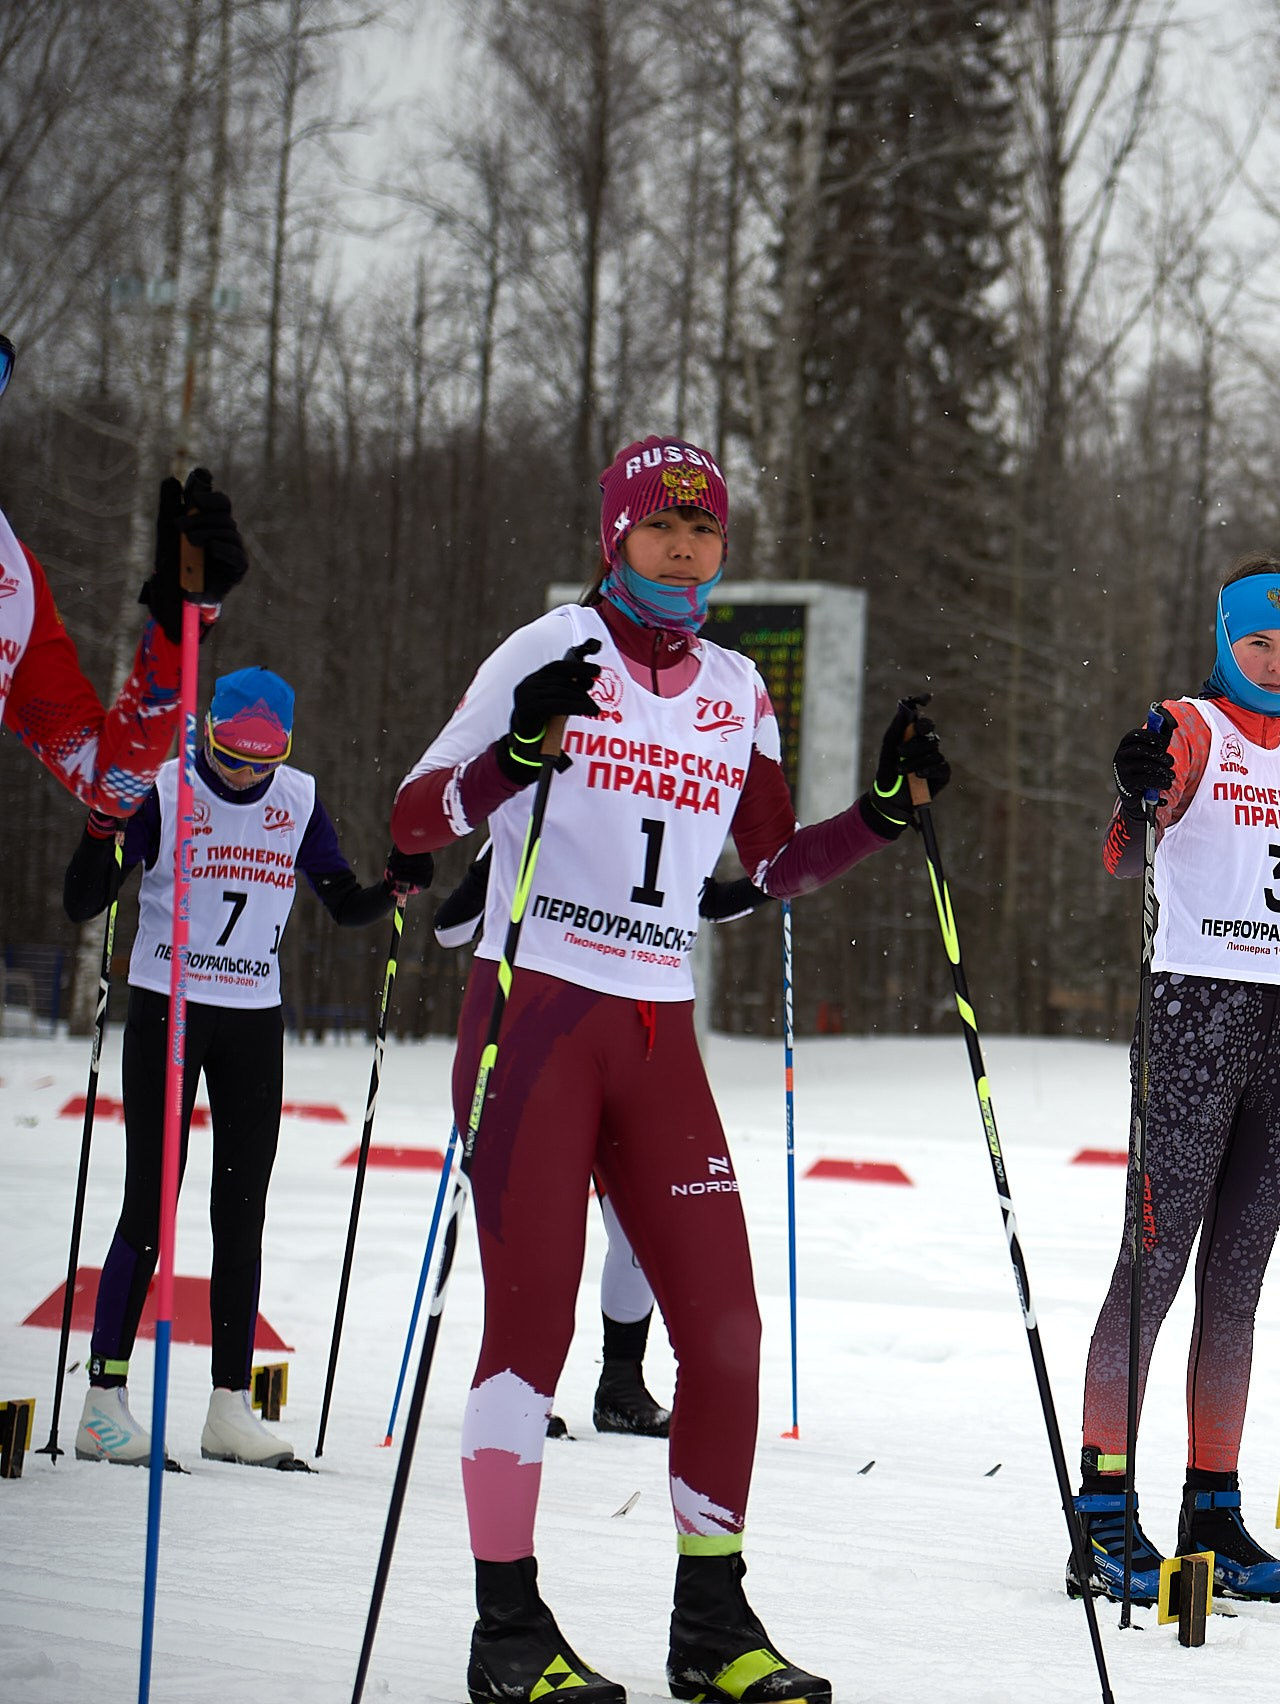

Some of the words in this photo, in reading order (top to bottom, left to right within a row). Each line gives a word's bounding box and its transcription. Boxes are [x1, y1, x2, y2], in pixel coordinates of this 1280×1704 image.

[695, 696, 733, 720] 70
[563, 730, 745, 791] ПИОНЕРСКАЯ
[586, 761, 721, 816] ПРАВДА
[264, 806, 289, 823] 70
[191, 866, 296, 890] ОЛИМПИАДЕ
[629, 817, 666, 908] 1
[216, 891, 248, 947] 7
[563, 931, 627, 958] Пионерка
